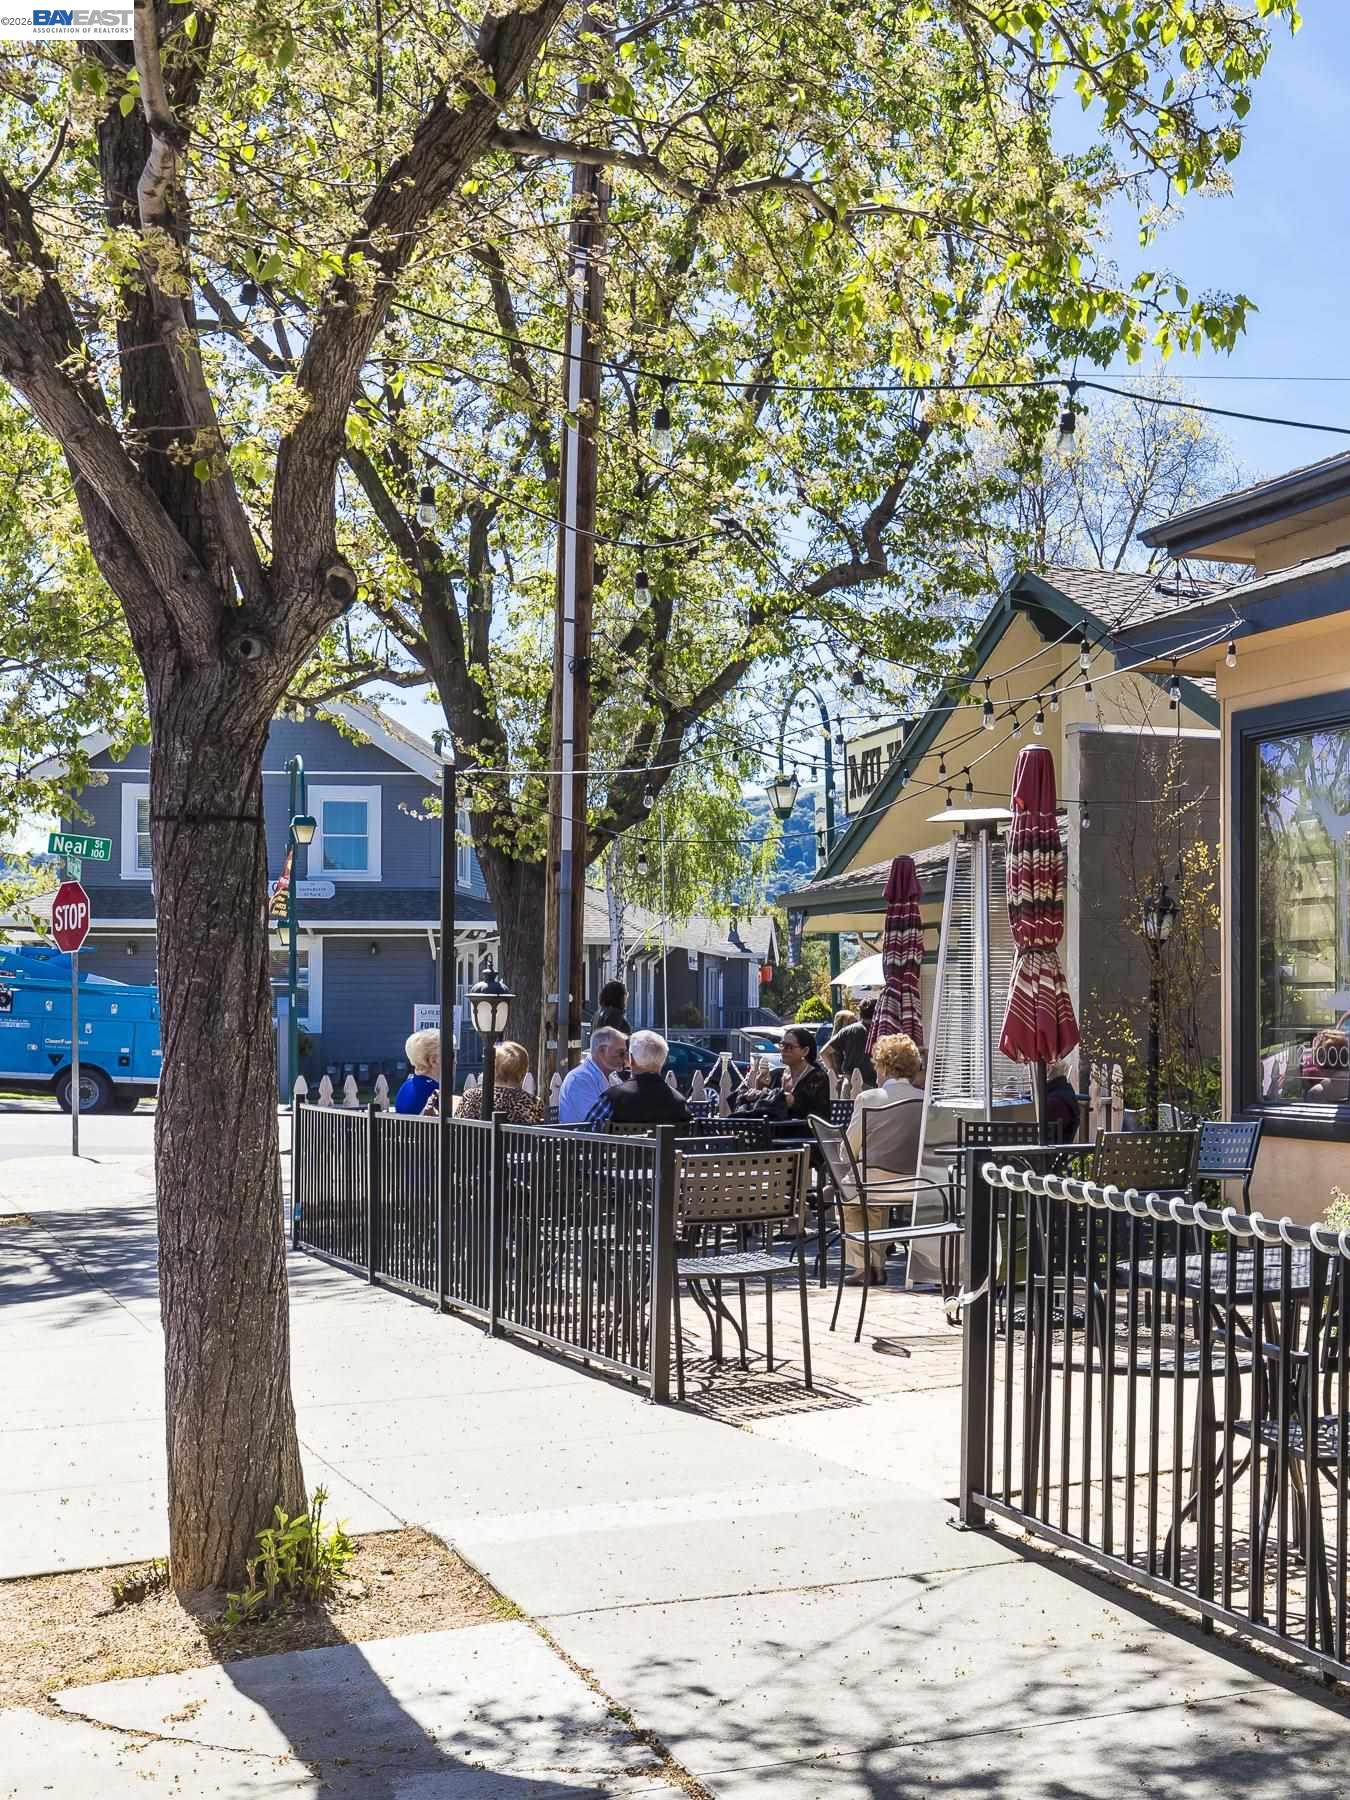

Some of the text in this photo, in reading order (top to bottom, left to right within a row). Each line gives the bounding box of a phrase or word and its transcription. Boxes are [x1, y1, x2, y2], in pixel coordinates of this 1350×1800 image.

[53, 836, 104, 855] Neal St
[91, 849, 105, 859] 100
[55, 903, 87, 931] STOP
